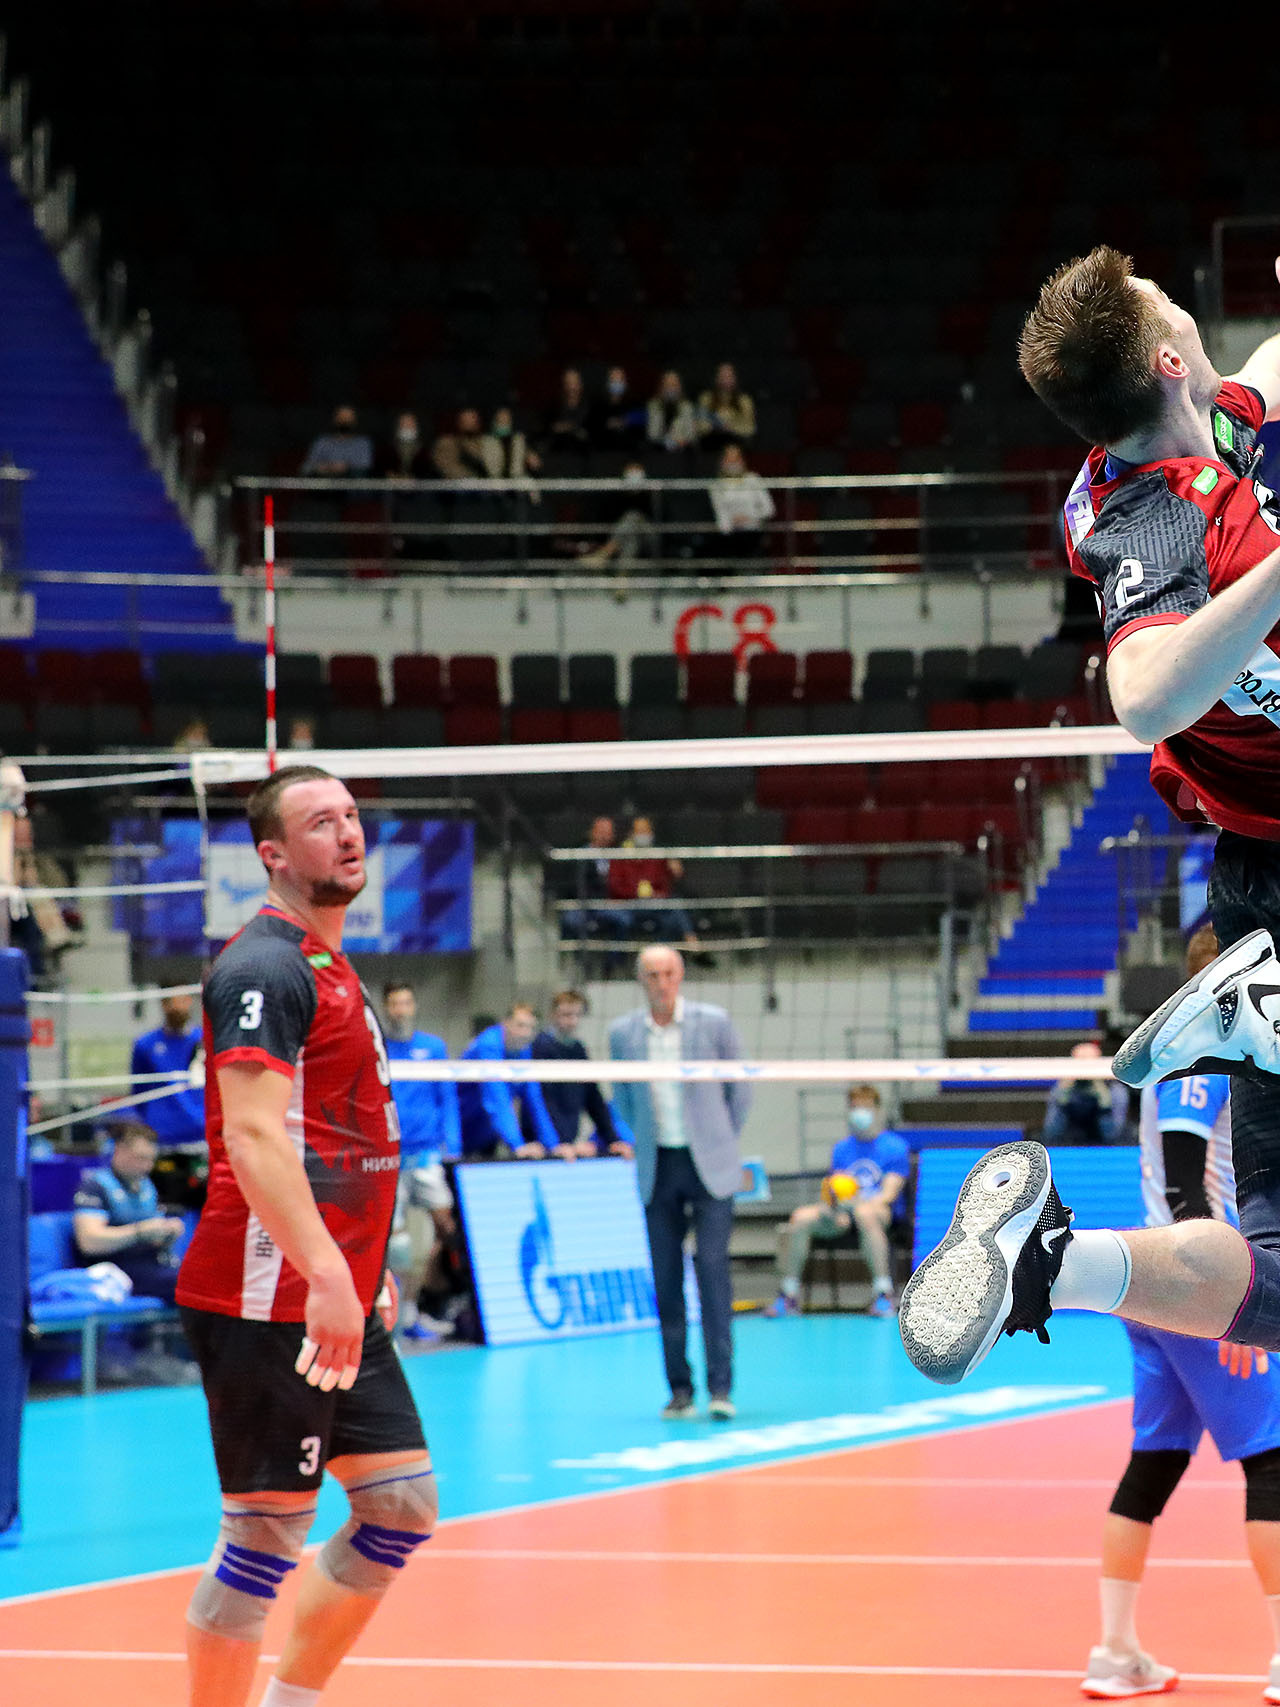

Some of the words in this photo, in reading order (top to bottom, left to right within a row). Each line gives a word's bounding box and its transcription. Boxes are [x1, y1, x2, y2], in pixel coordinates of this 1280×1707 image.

[1114, 559, 1146, 609] 2
[674, 603, 777, 670] C8
[238, 990, 264, 1030] 3
[1180, 1077, 1209, 1109] 15
[299, 1436, 321, 1476] 3
